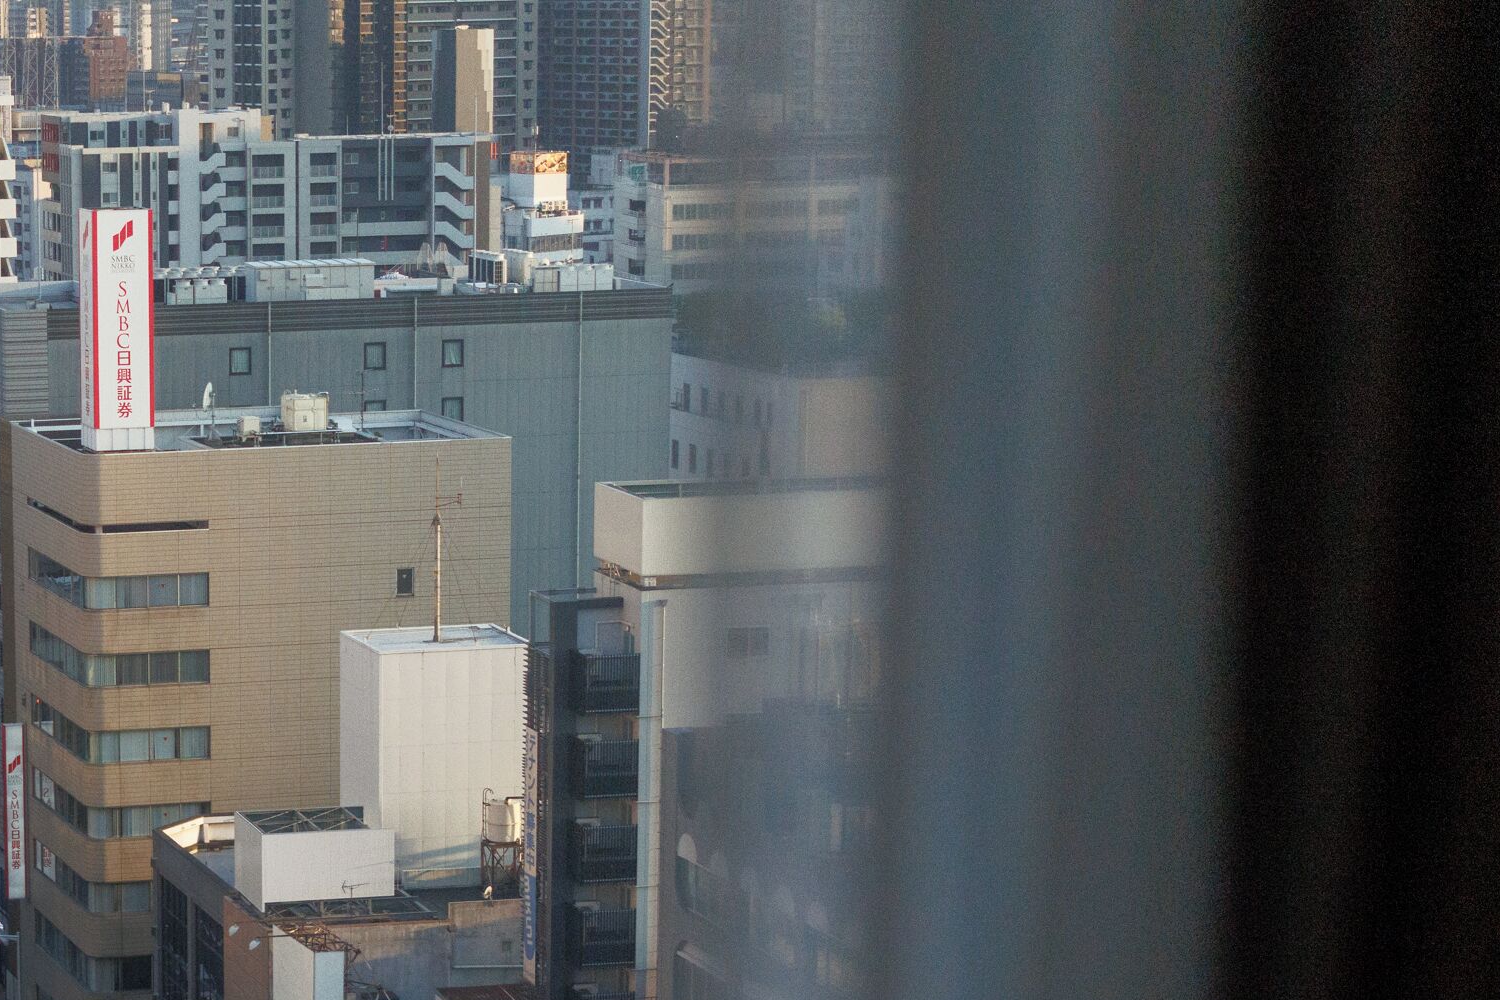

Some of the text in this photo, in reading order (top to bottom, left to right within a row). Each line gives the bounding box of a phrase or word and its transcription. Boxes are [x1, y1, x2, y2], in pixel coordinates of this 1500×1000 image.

[111, 254, 135, 263] SMBC
[116, 280, 133, 418] SMBC日興証券
[10, 788, 21, 870] SMBC日興証券
